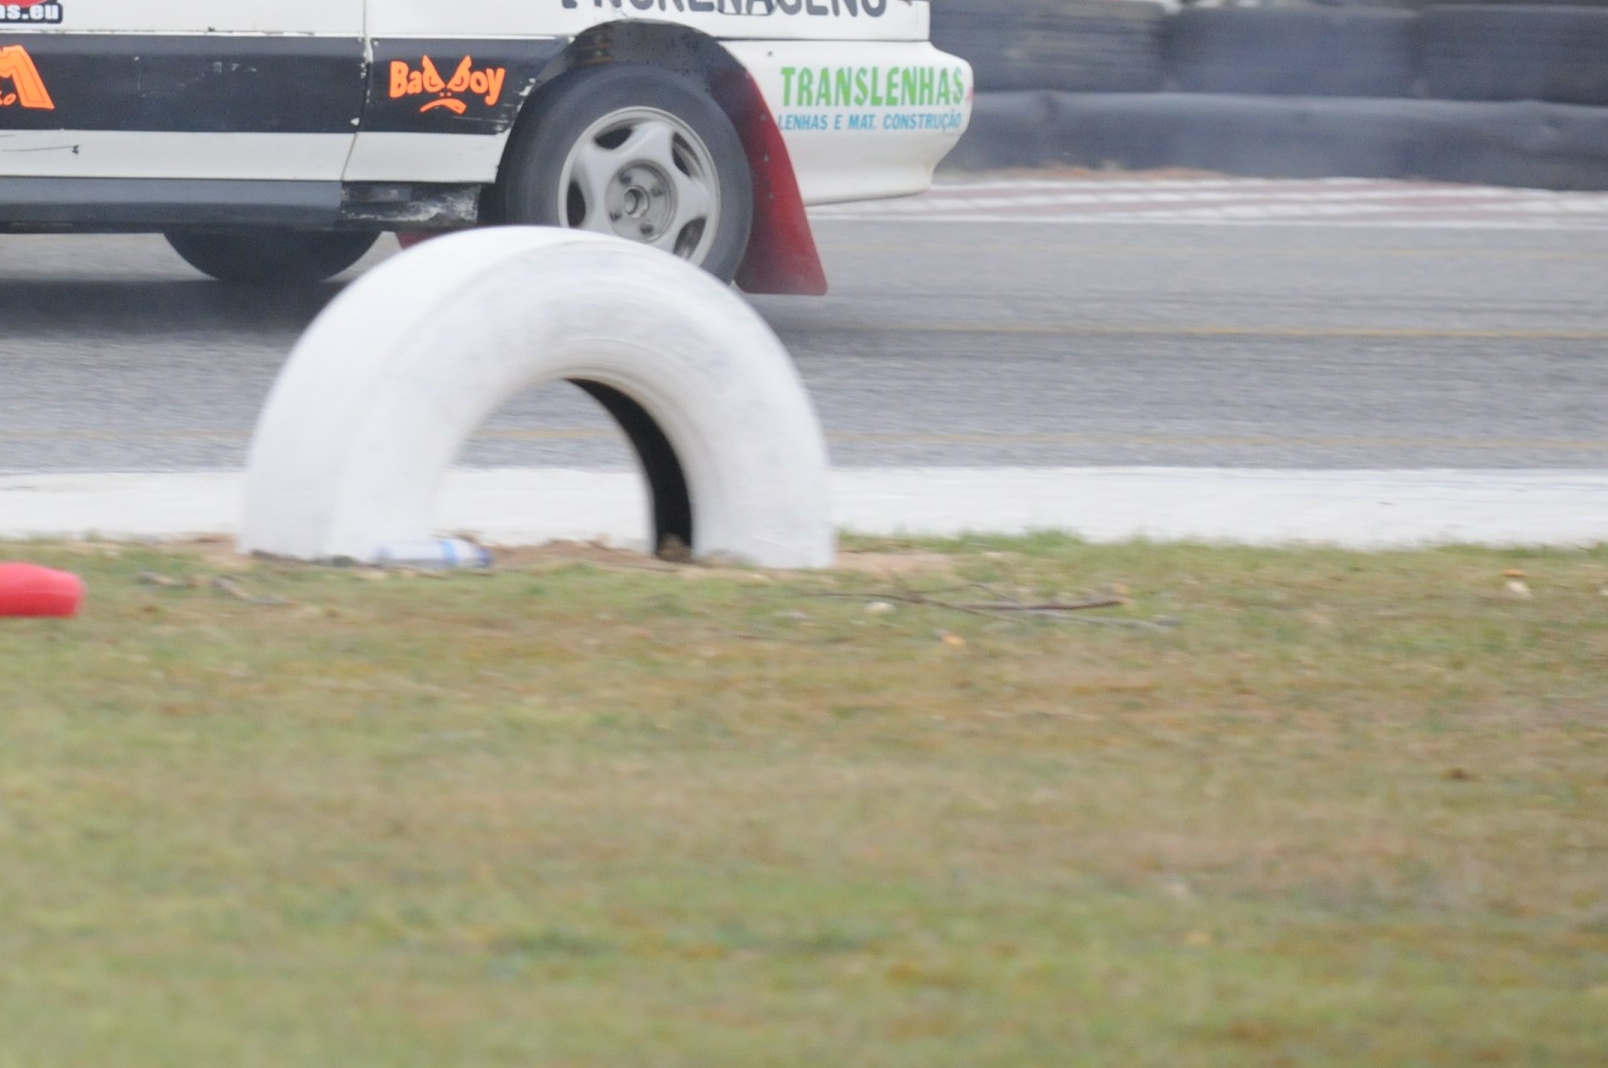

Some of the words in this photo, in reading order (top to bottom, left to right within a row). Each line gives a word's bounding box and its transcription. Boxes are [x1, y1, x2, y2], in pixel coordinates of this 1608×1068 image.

[779, 65, 965, 107] TRANSLENHAS
[778, 113, 828, 131] LENHAS
[833, 113, 844, 130] E
[847, 113, 878, 130] MAT.
